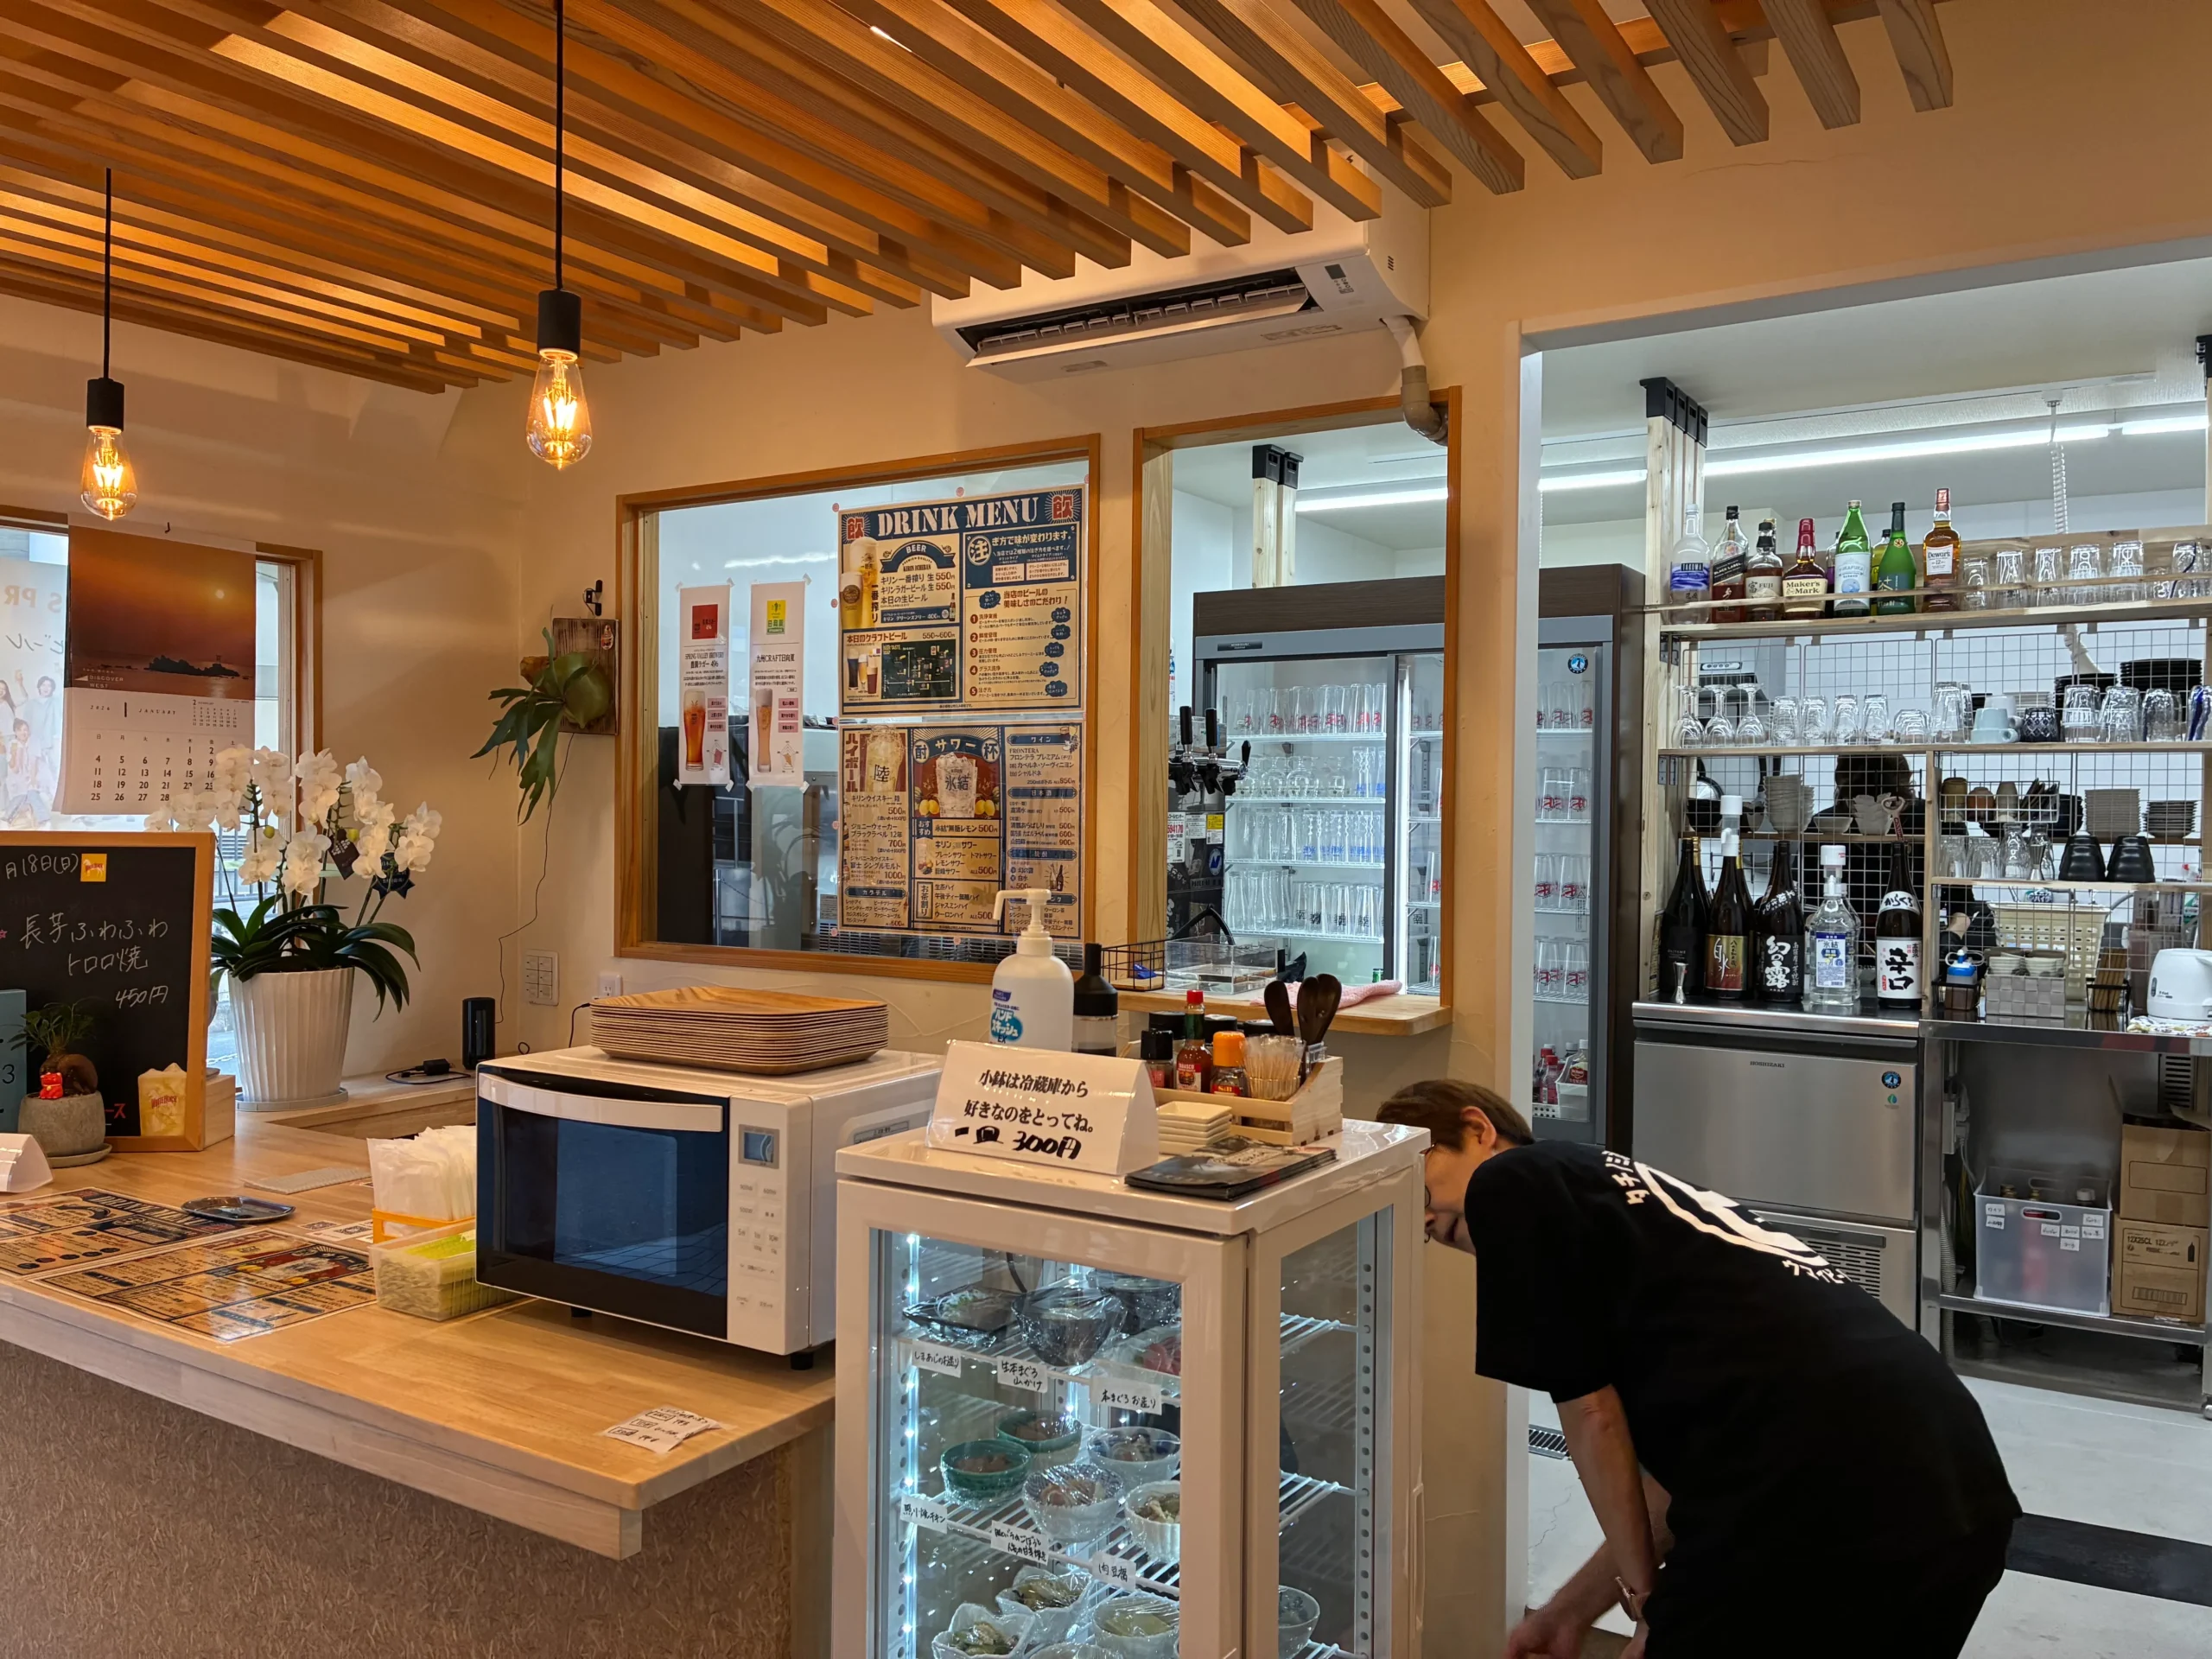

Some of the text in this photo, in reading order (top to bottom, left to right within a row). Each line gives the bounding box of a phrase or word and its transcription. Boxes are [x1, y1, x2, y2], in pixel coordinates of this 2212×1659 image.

[877, 497, 1039, 537] DRINK MENU
[1052, 495, 1073, 520] 飲
[906, 543, 926, 554] BEER
[991, 531, 1071, 547] ぎ方で味が変わります。
[969, 539, 989, 563] 注
[881, 574, 925, 585] キリン一番搾り
[881, 583, 926, 594] キリンラガービール
[928, 583, 934, 592] 生
[1786, 581, 1821, 590] Maker's
[871, 584, 880, 623] 一番搾り
[881, 594, 929, 605] 本日の生ビール
[1003, 588, 1048, 599] 当店のビールの
[847, 632, 908, 643] 本日のクラフトビール
[934, 739, 976, 753] サワー
[983, 743, 999, 760] 杯
[845, 733, 859, 793] ハイボール
[874, 764, 891, 783] 陸
[118, 780, 125, 789] 19
[945, 774, 969, 791] 氷結
[920, 885, 929, 916] お茶割り
[20, 912, 168, 950] 長芋ふわふわ
[67, 945, 149, 976] トロロ焼
[1764, 935, 1791, 989] 幻の露
[1885, 947, 1915, 991] 辛口
[115, 985, 169, 1009] 450円
[995, 1009, 1014, 1022] ハンド
[991, 1019, 1019, 1037] スキッシュ
[997, 1034, 1007, 1044] EX
[978, 1069, 1090, 1098] 小鉢は冷蔵庫から
[963, 1099, 1094, 1133] 好きなのをとってね。
[1012, 1130, 1083, 1160] 300円
